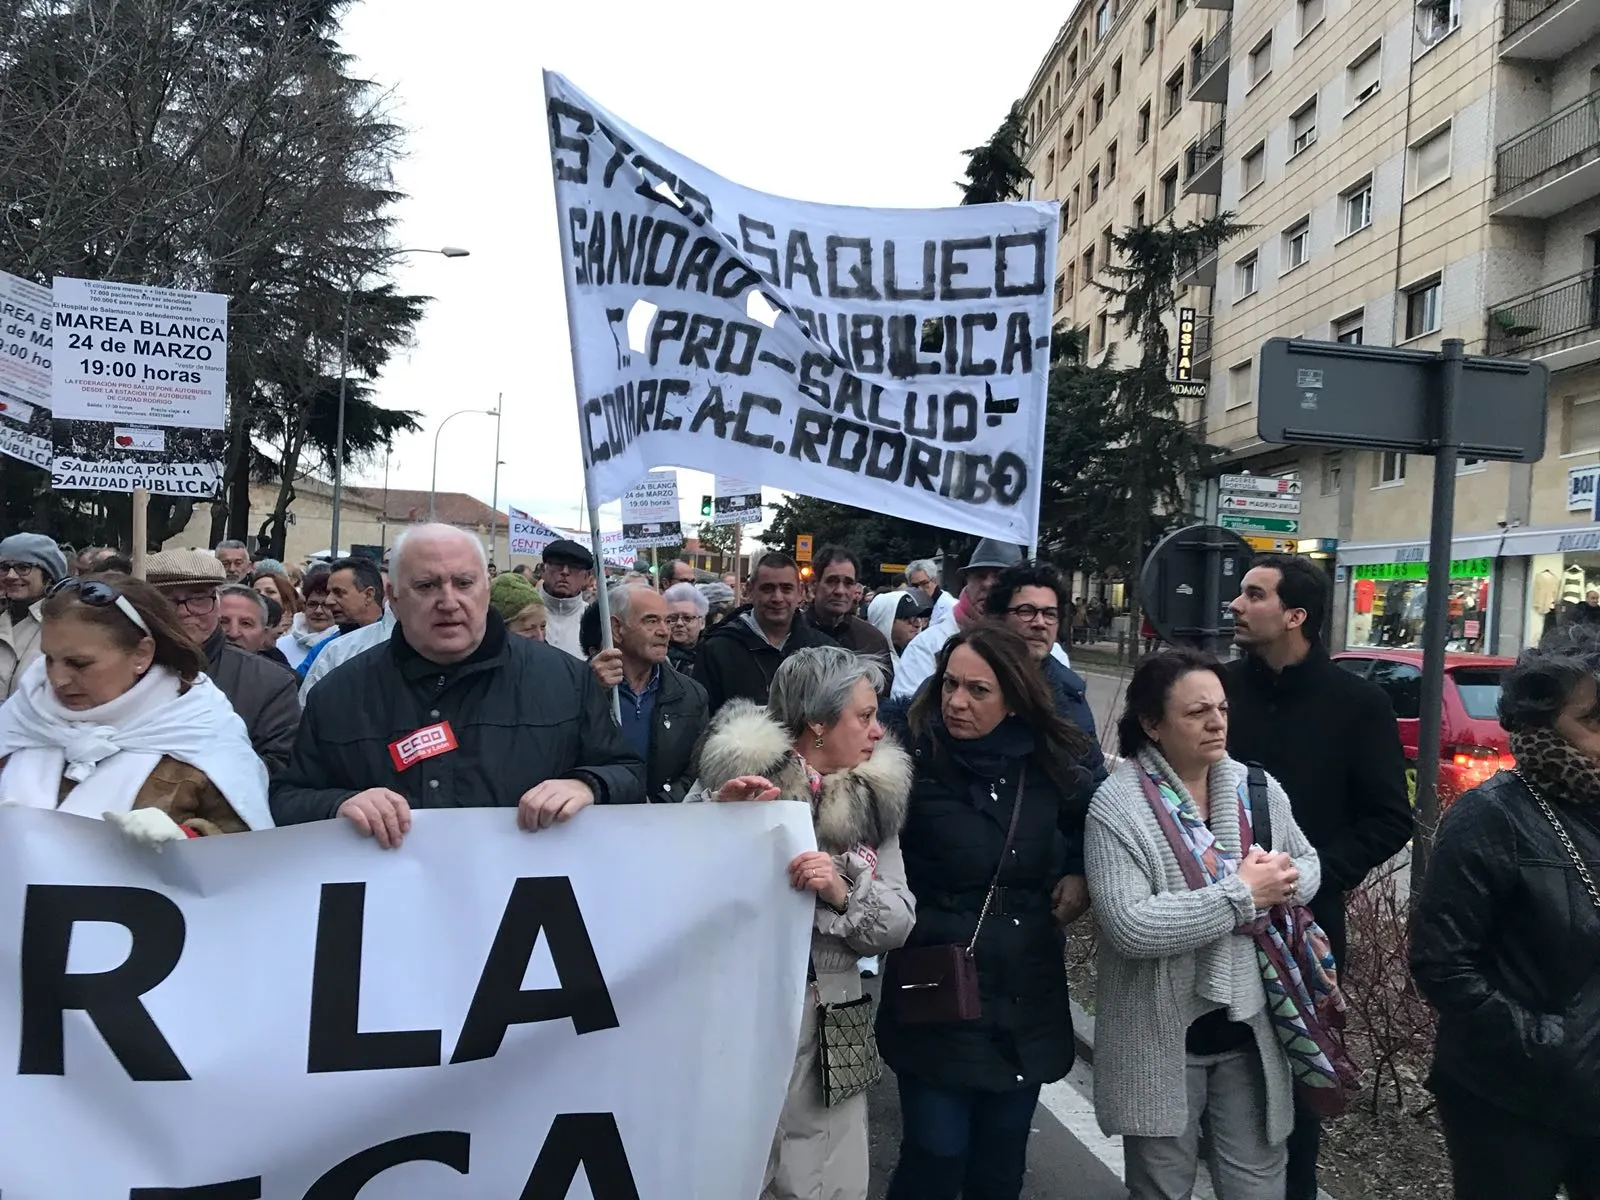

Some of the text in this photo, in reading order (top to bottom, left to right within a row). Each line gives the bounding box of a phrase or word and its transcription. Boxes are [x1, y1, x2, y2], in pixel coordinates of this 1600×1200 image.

[569, 207, 762, 299] SANIDAD
[738, 213, 1047, 300] SAQUEO
[61, 302, 88, 311] Hospital
[100, 306, 136, 316] Salamanca
[144, 311, 183, 320] defendemos
[7, 323, 25, 337] de
[56, 311, 225, 342] MAREA BLANCA
[68, 333, 212, 361] 24 de MARZO
[1178, 309, 1193, 380] HOSTAL
[80, 359, 201, 383] 19:00 horas
[133, 383, 155, 391] SALUD
[174, 387, 212, 396] AUTOBUSES
[159, 392, 196, 400] AUTOBUSES
[117, 395, 142, 403] CIUDAD
[60, 460, 204, 477] SALAMANCA POR LA
[51, 473, 128, 489] SANIDAD
[647, 482, 677, 490] BLANCA
[1355, 564, 1408, 577] OFERTAS
[306, 876, 620, 1073] LA
